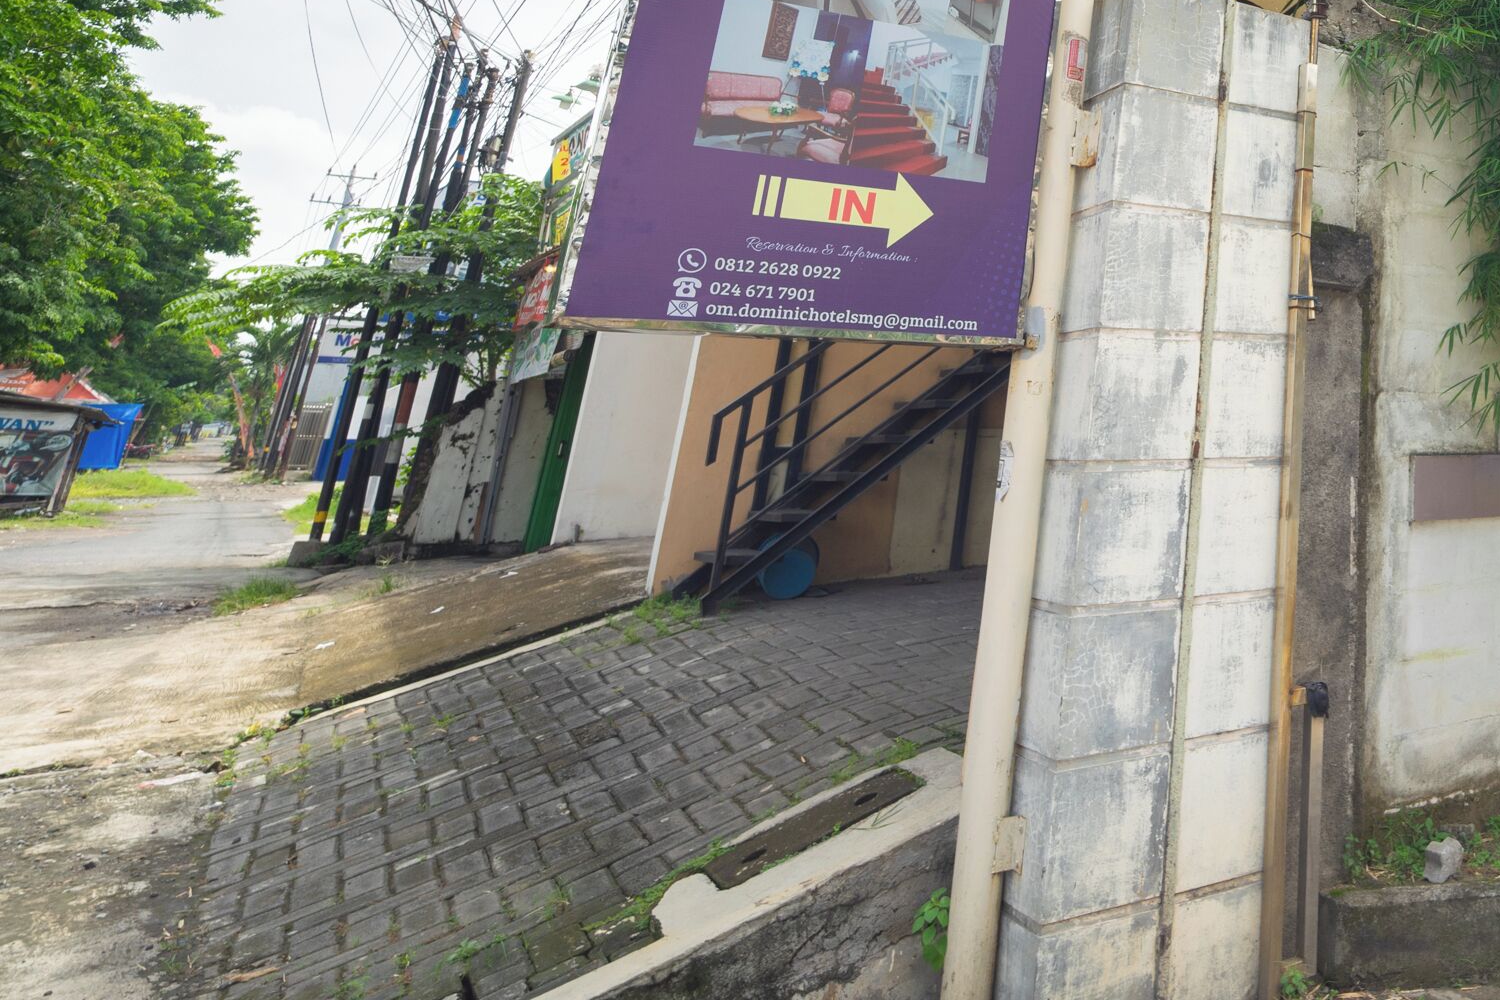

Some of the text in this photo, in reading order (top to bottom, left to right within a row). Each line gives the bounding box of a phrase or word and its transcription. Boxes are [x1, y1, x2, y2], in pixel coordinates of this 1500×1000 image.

[827, 187, 877, 225] IN
[746, 236, 818, 255] Reservation
[822, 243, 834, 256] &
[838, 245, 911, 263] Information
[714, 257, 841, 280] 0812 2628 0922
[709, 281, 816, 302] 024 671 7901
[705, 302, 978, 331] om.dominichotelsmg@gmail.com
